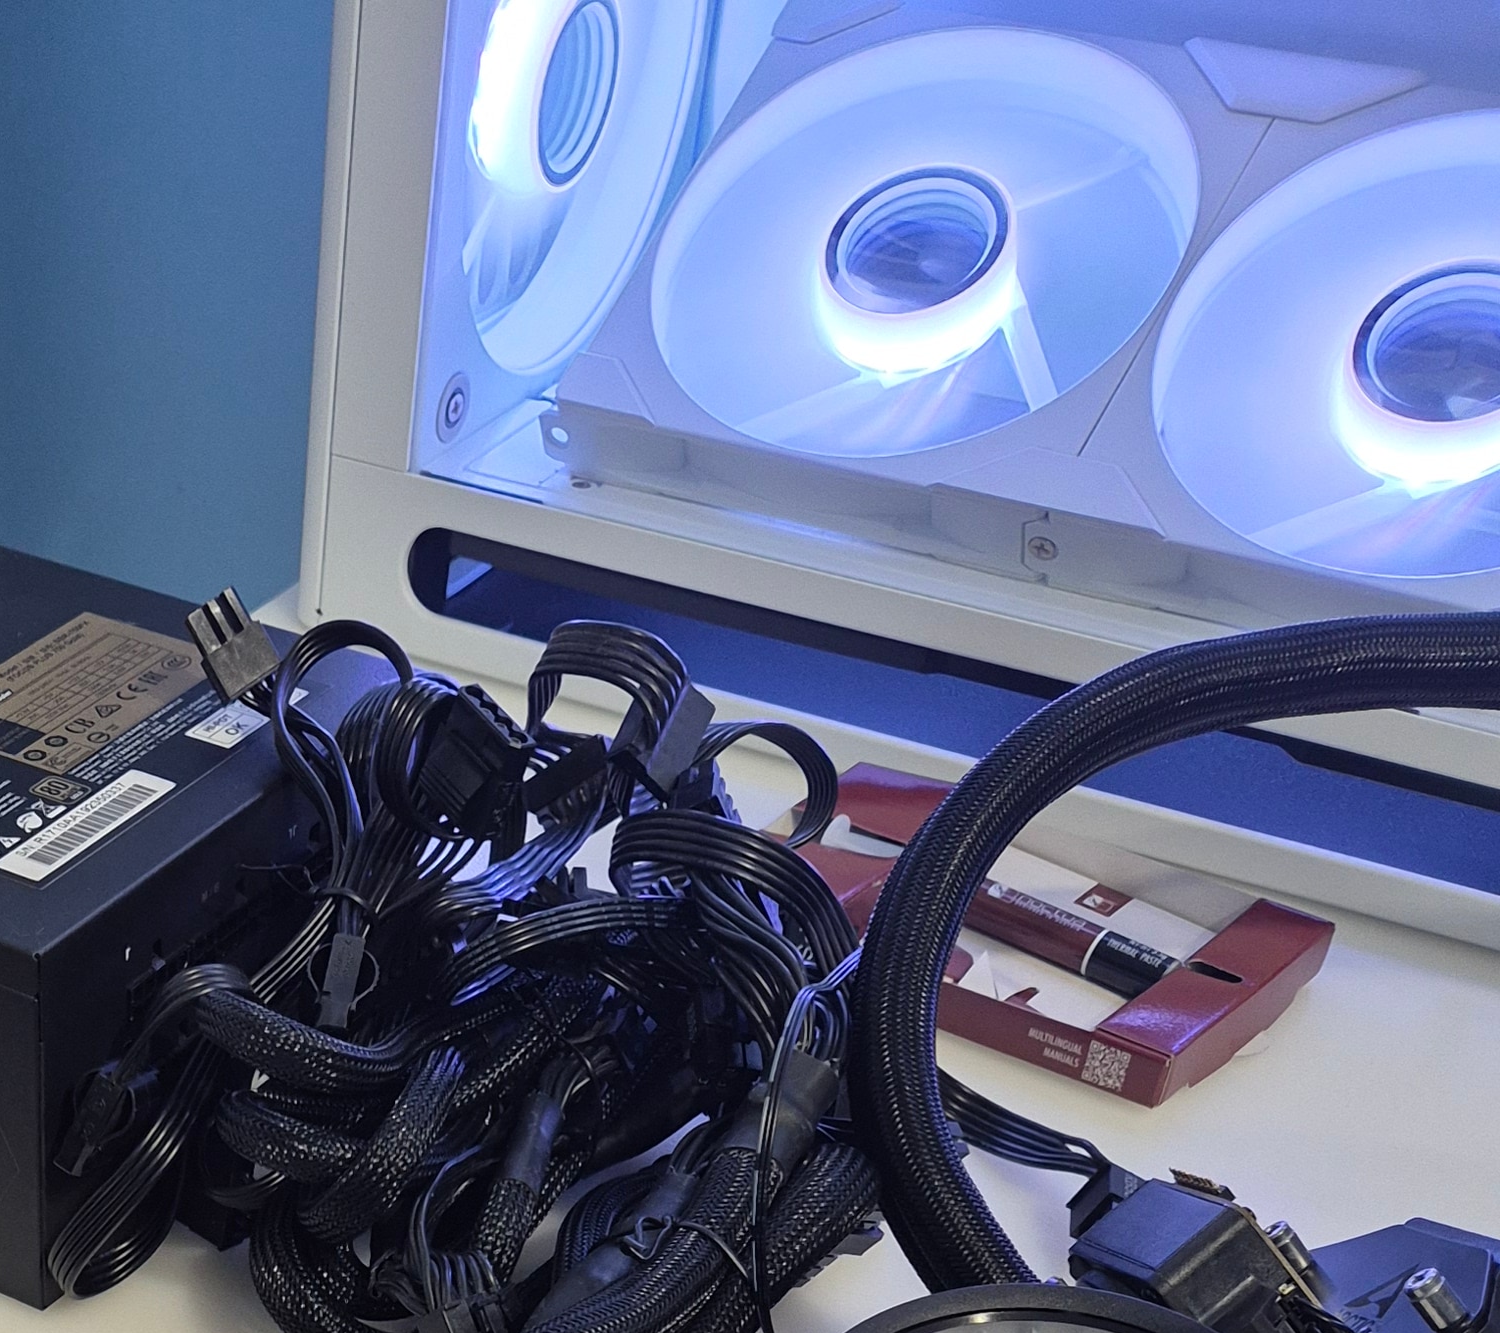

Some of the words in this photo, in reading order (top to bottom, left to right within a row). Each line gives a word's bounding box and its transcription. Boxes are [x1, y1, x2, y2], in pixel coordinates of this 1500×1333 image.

[225, 722, 248, 735] OK
[46, 780, 71, 797] 80
[1028, 1028, 1083, 1055] MULTILINGUAL
[1043, 1047, 1080, 1068] MANUALS
